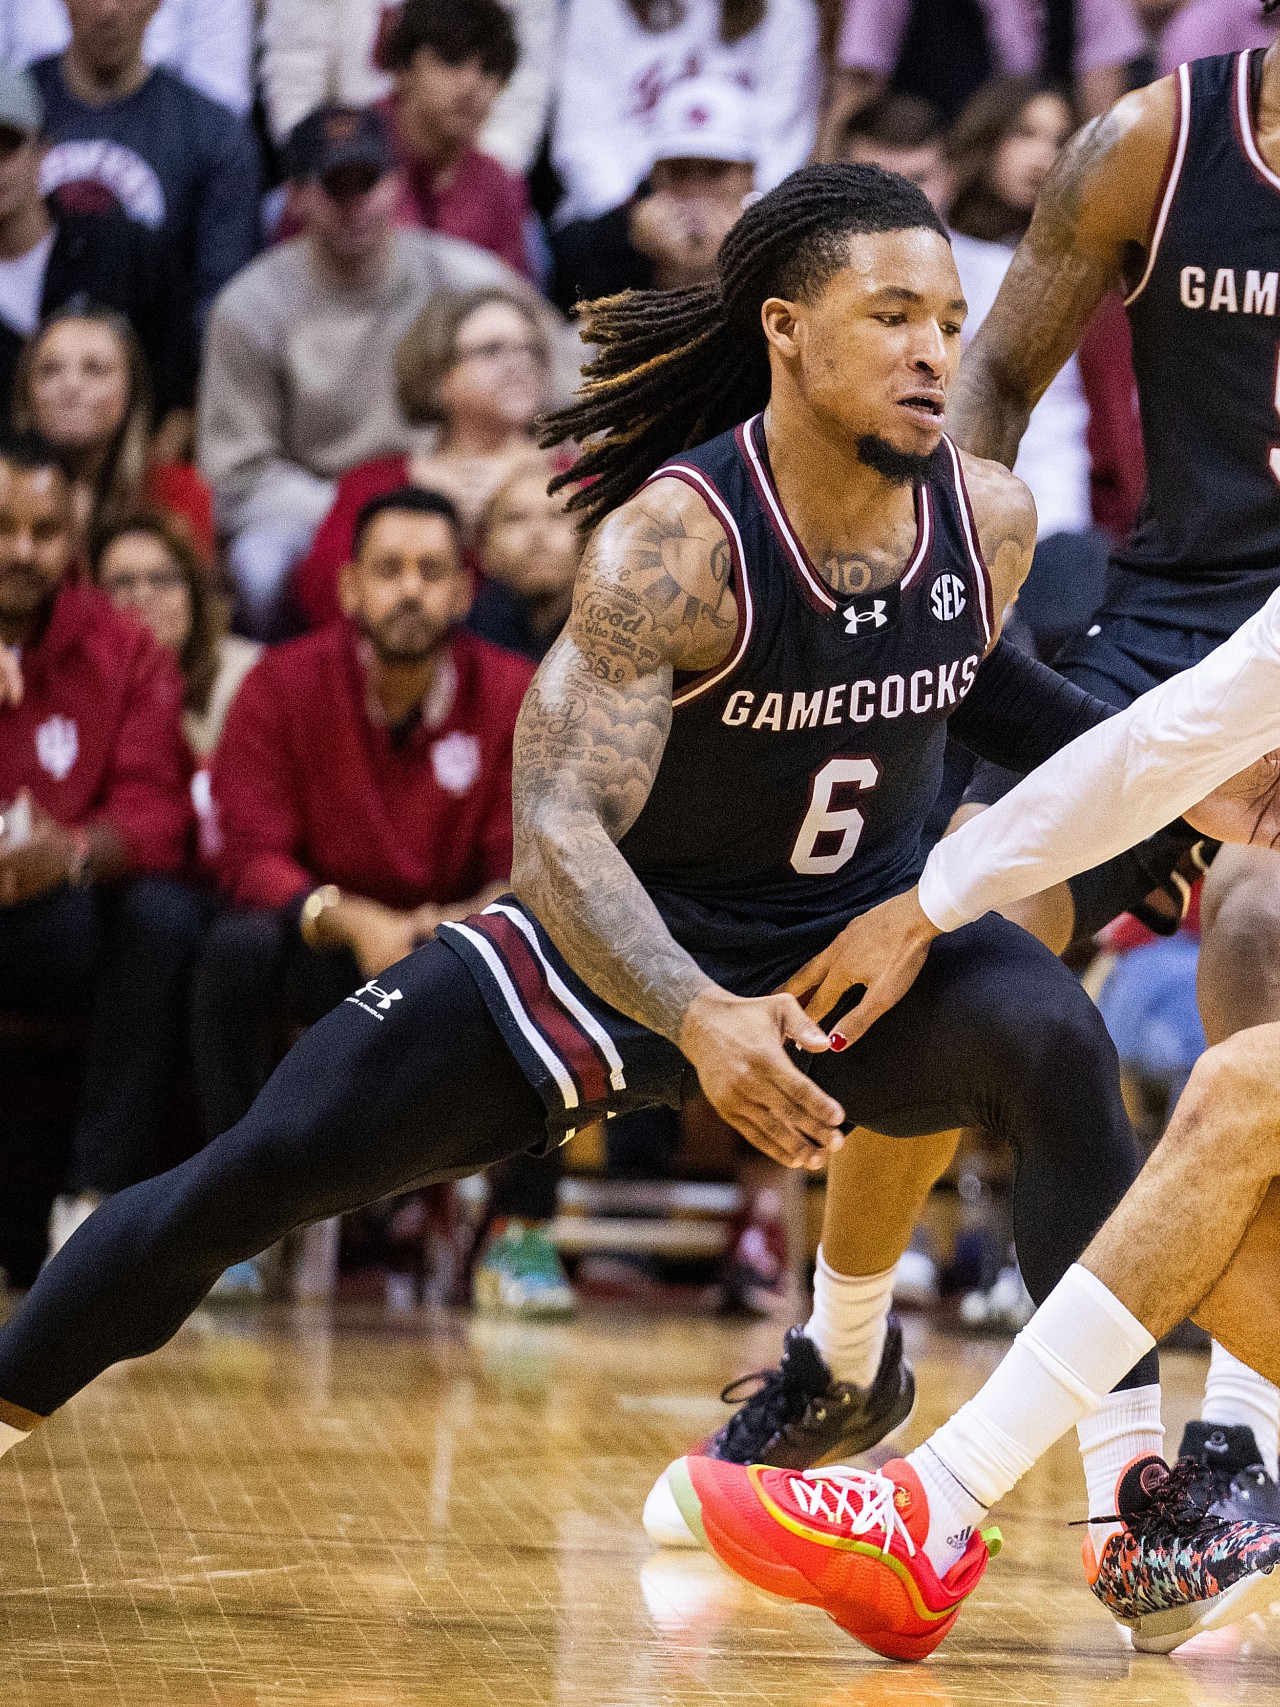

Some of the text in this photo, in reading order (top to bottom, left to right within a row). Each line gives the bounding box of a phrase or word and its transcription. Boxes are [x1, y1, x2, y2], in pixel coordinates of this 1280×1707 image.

[930, 574, 967, 622] SEC
[722, 655, 978, 731] GAMECOCKS
[790, 758, 879, 875] 6
